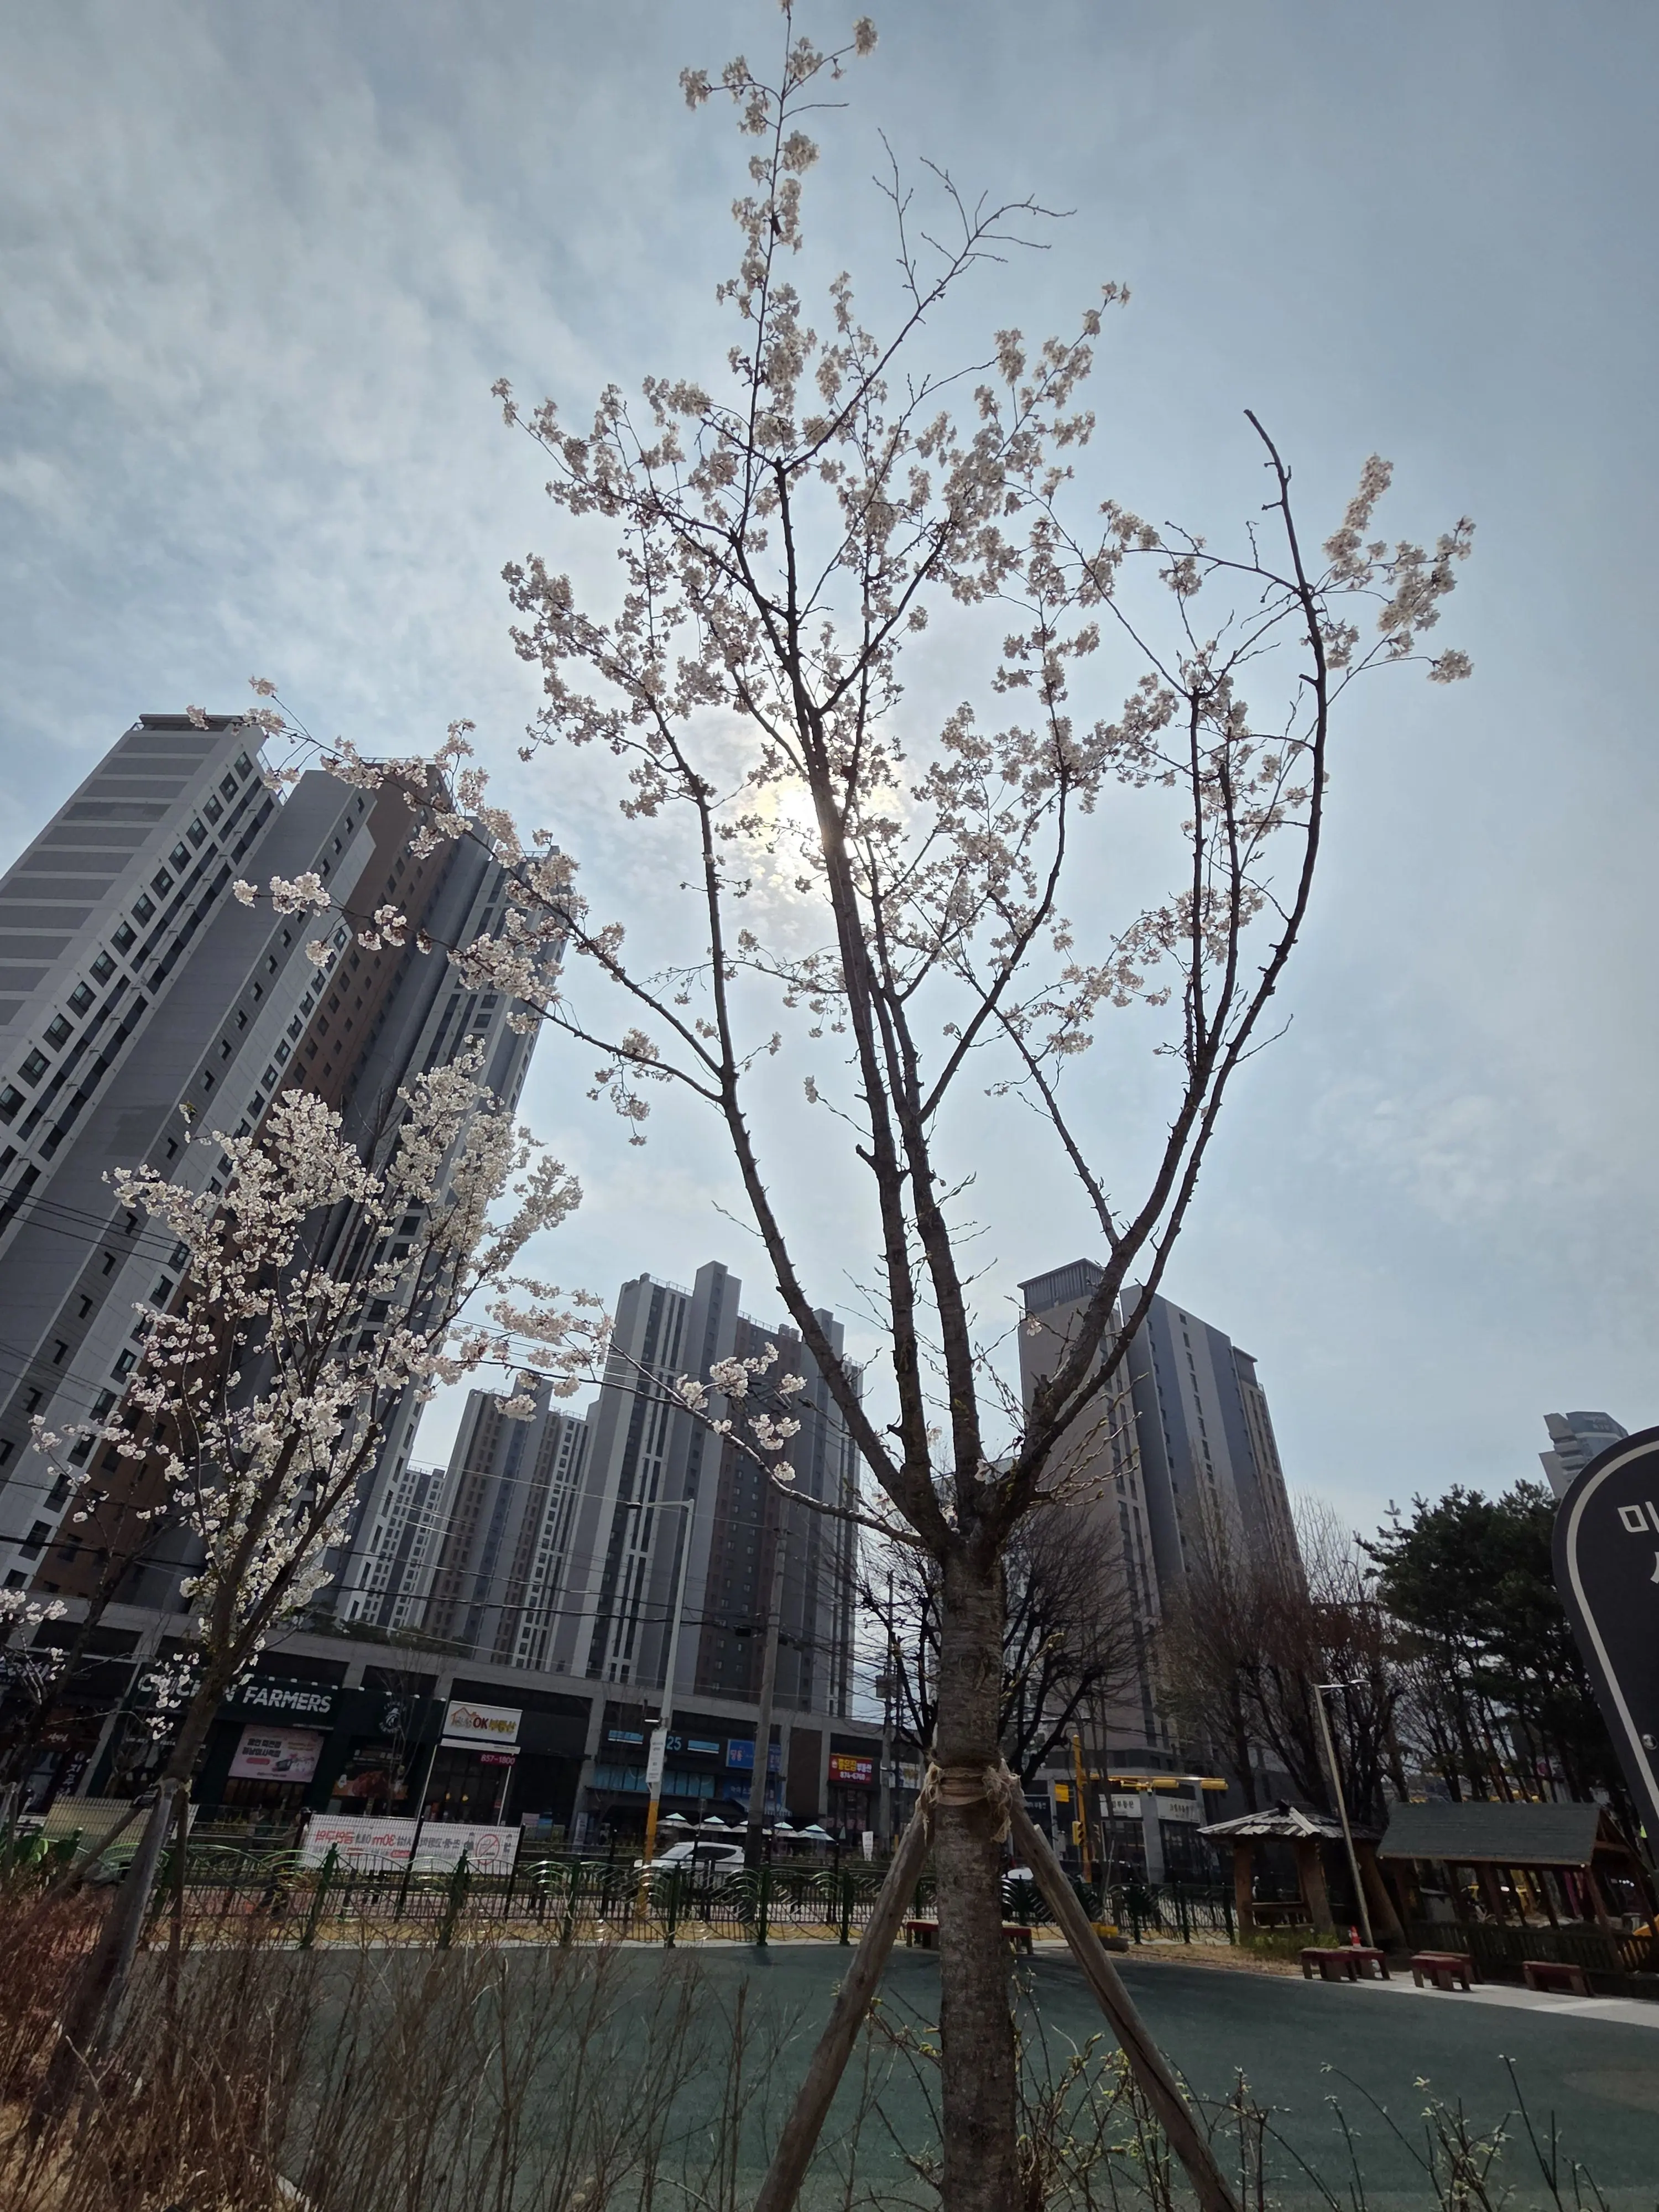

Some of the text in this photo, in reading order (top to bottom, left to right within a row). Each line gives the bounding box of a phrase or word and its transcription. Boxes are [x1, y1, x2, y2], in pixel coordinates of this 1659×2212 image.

[1618, 1501, 1659, 1533] 미
[242, 1686, 332, 1714] FARMERS
[473, 1717, 489, 1729] OK
[666, 1735, 682, 1751] 25
